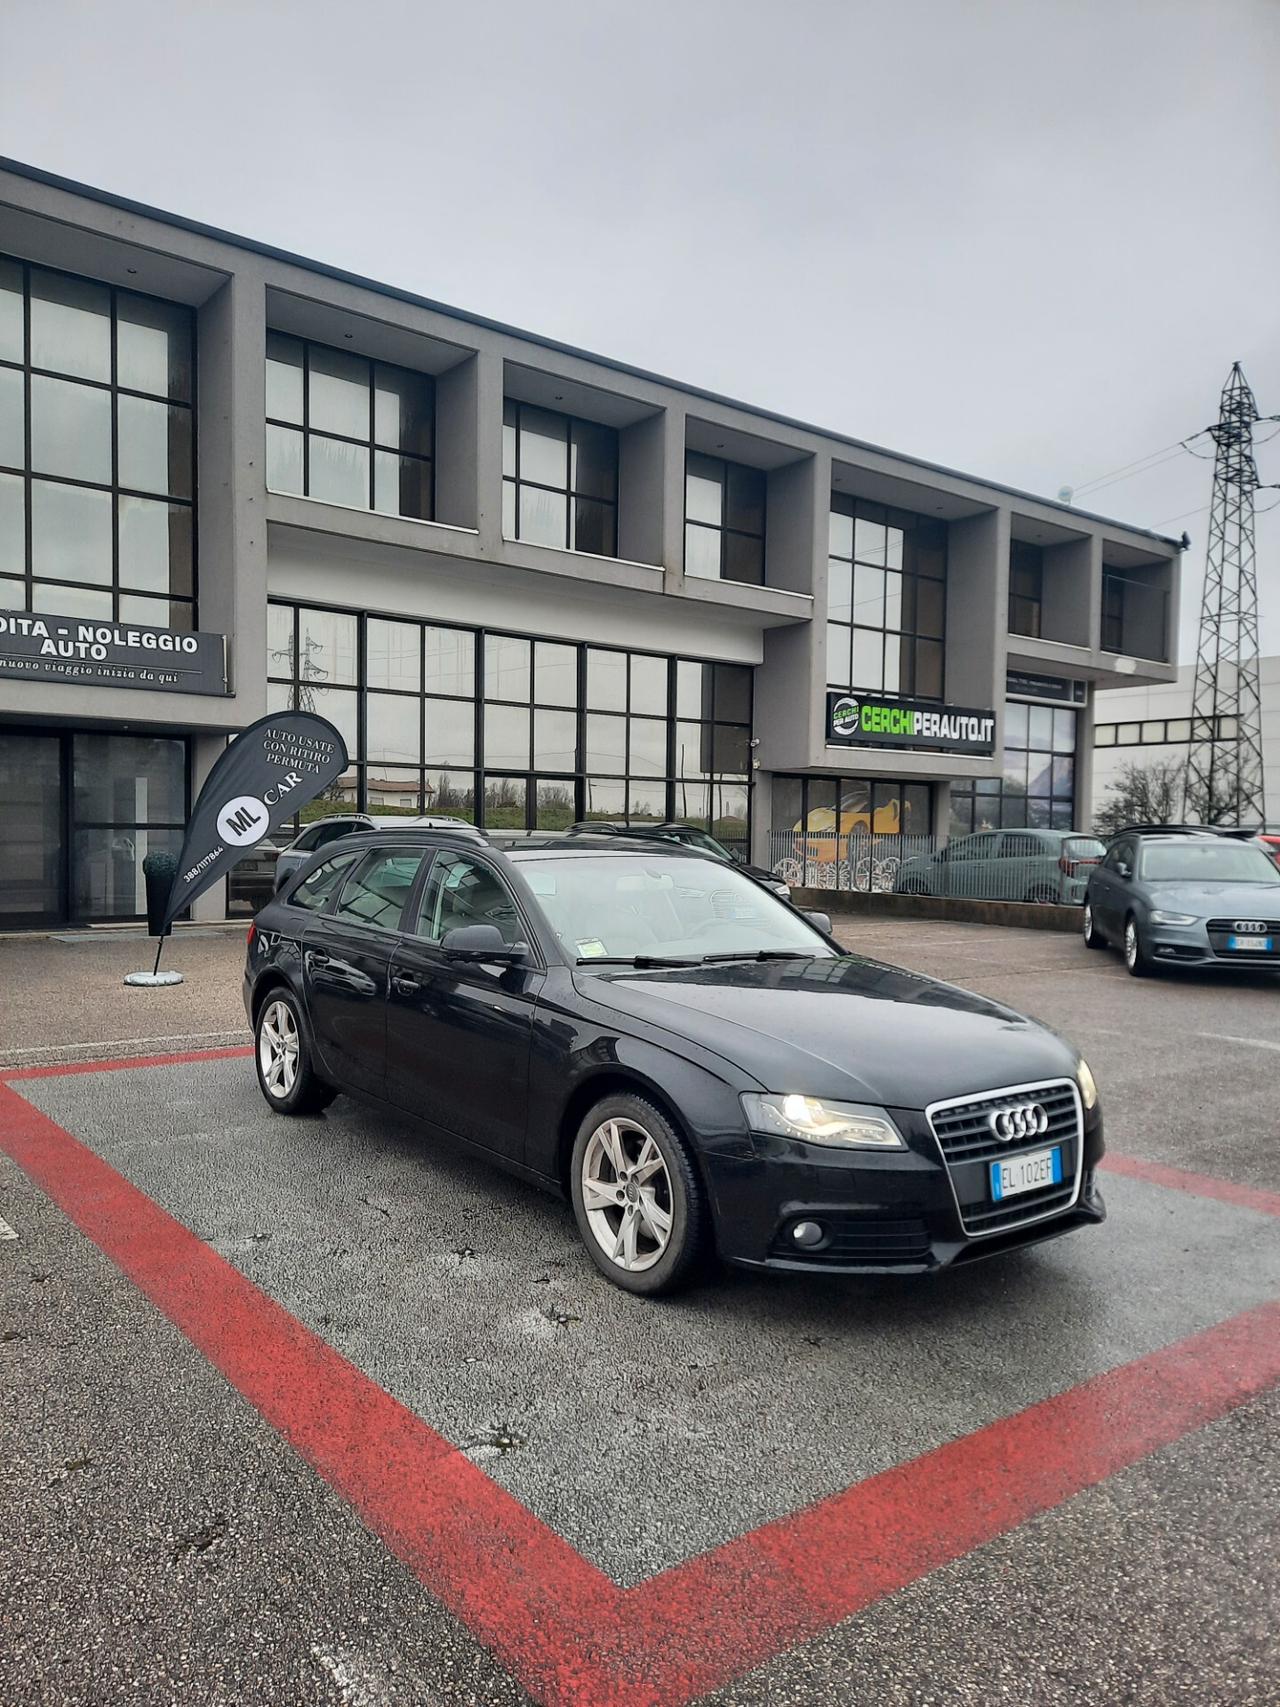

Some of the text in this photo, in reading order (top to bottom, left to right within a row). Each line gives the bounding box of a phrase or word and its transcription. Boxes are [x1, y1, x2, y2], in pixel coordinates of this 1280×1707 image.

[40, 639, 107, 660] AUTO
[78, 625, 198, 653] NOLEGGIO
[45, 661, 92, 676] viaggio
[97, 666, 135, 678] inizia
[140, 669, 154, 680] da
[159, 672, 178, 684] qui
[861, 705, 994, 742] CERCHIPERAUTO.IT
[263, 740, 330, 764] CON RITIRO
[264, 728, 335, 753] AUTO USATE
[266, 753, 319, 774] PERMUTA
[225, 772, 303, 837] ML CAR
[1002, 1157, 1052, 1189] EL 102EF
